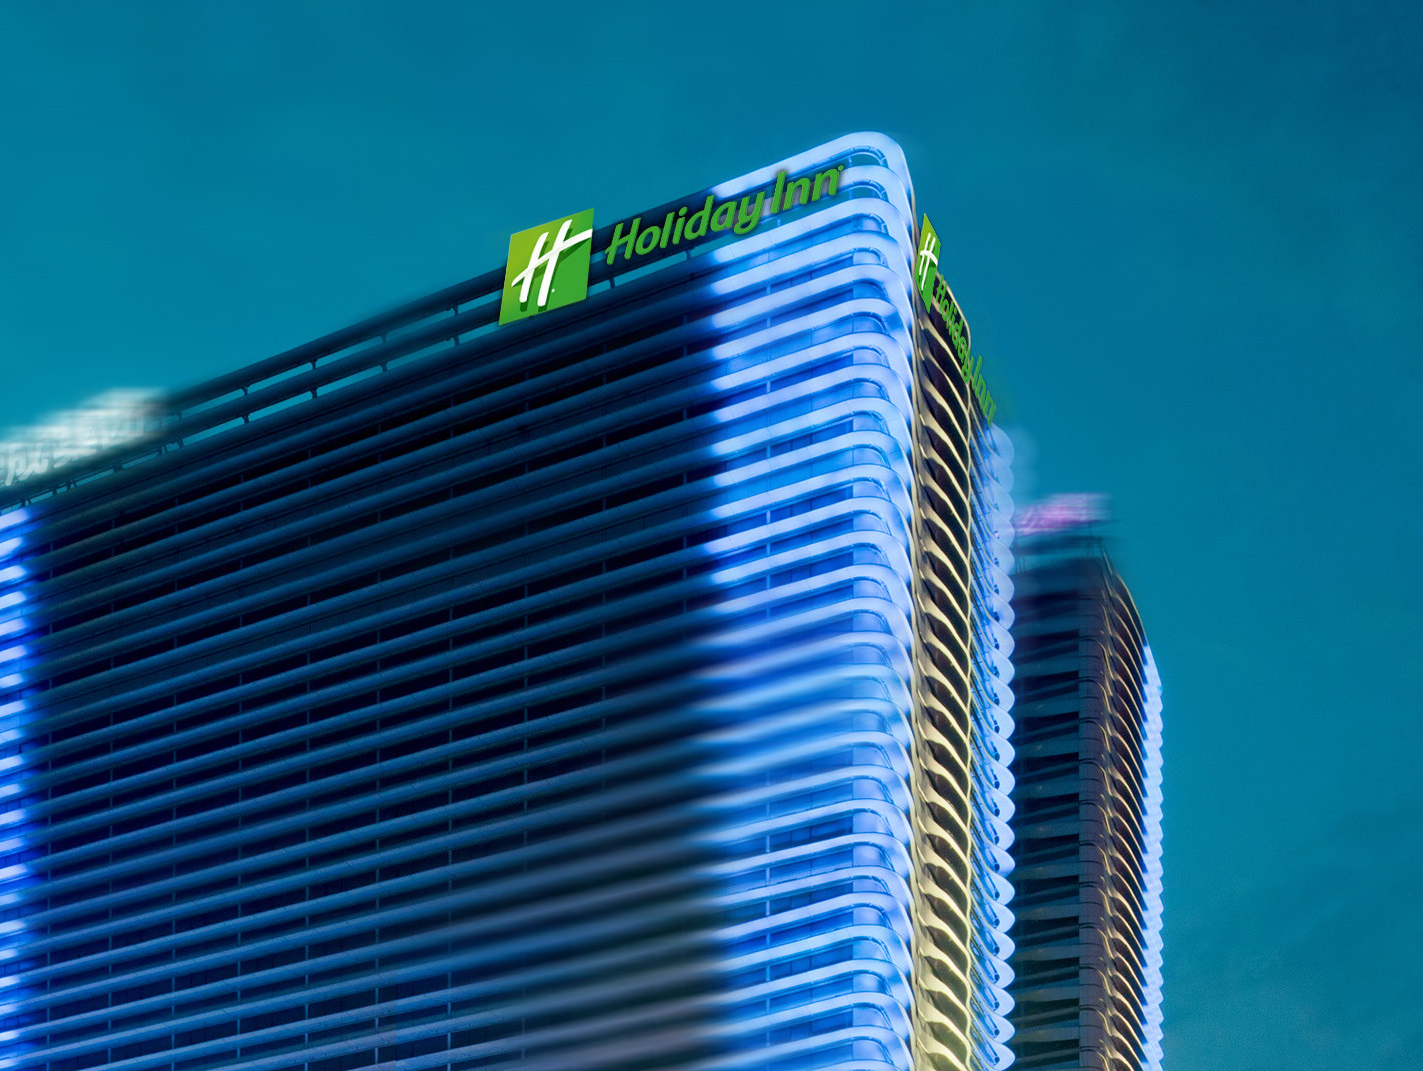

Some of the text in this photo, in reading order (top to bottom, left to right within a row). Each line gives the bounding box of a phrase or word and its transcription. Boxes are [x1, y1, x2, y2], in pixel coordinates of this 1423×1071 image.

[605, 170, 843, 265] Holiday Inn
[935, 274, 997, 427] Holiday Inn
